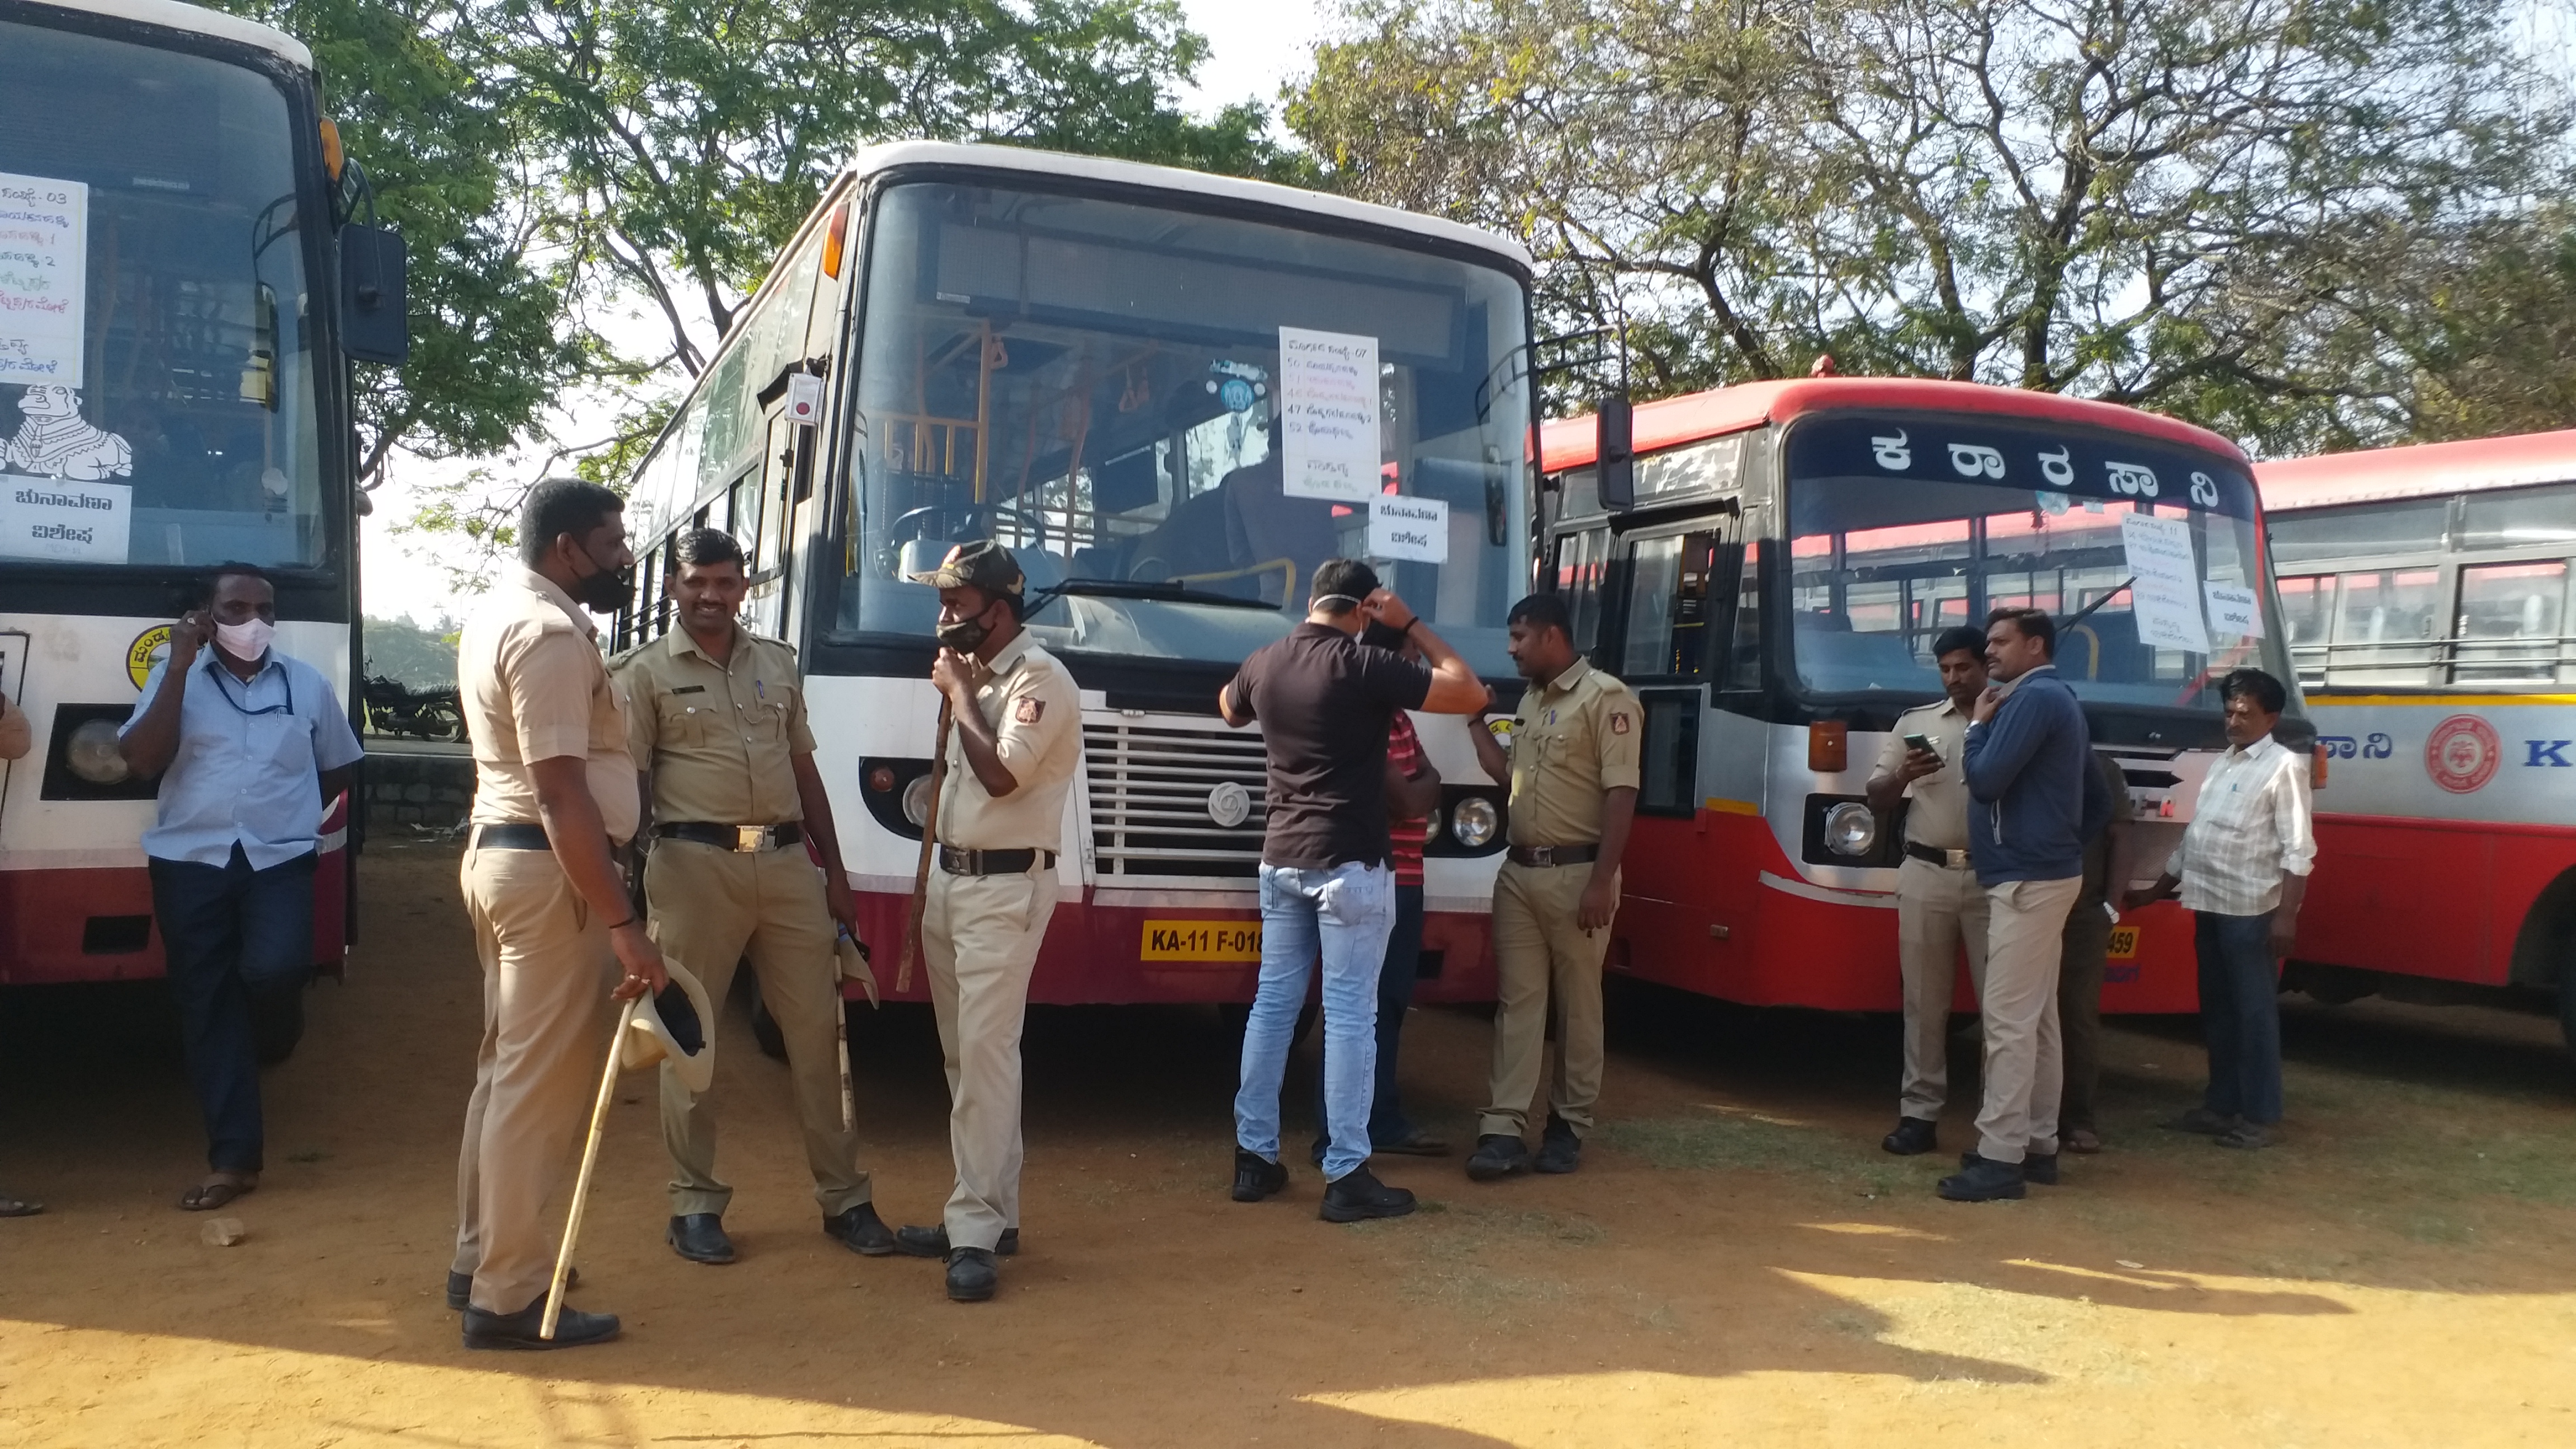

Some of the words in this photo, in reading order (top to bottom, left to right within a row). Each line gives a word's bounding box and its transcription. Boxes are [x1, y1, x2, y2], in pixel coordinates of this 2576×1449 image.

[46, 192, 67, 205] 03
[45, 256, 55, 267] 2
[1287, 404, 1301, 415] 47
[16, 489, 112, 510] ಚುನಾವಣಾ
[32, 523, 93, 544] ವಿಶೇಷ
[2523, 740, 2573, 767] K
[1152, 929, 1209, 951] KA-11
